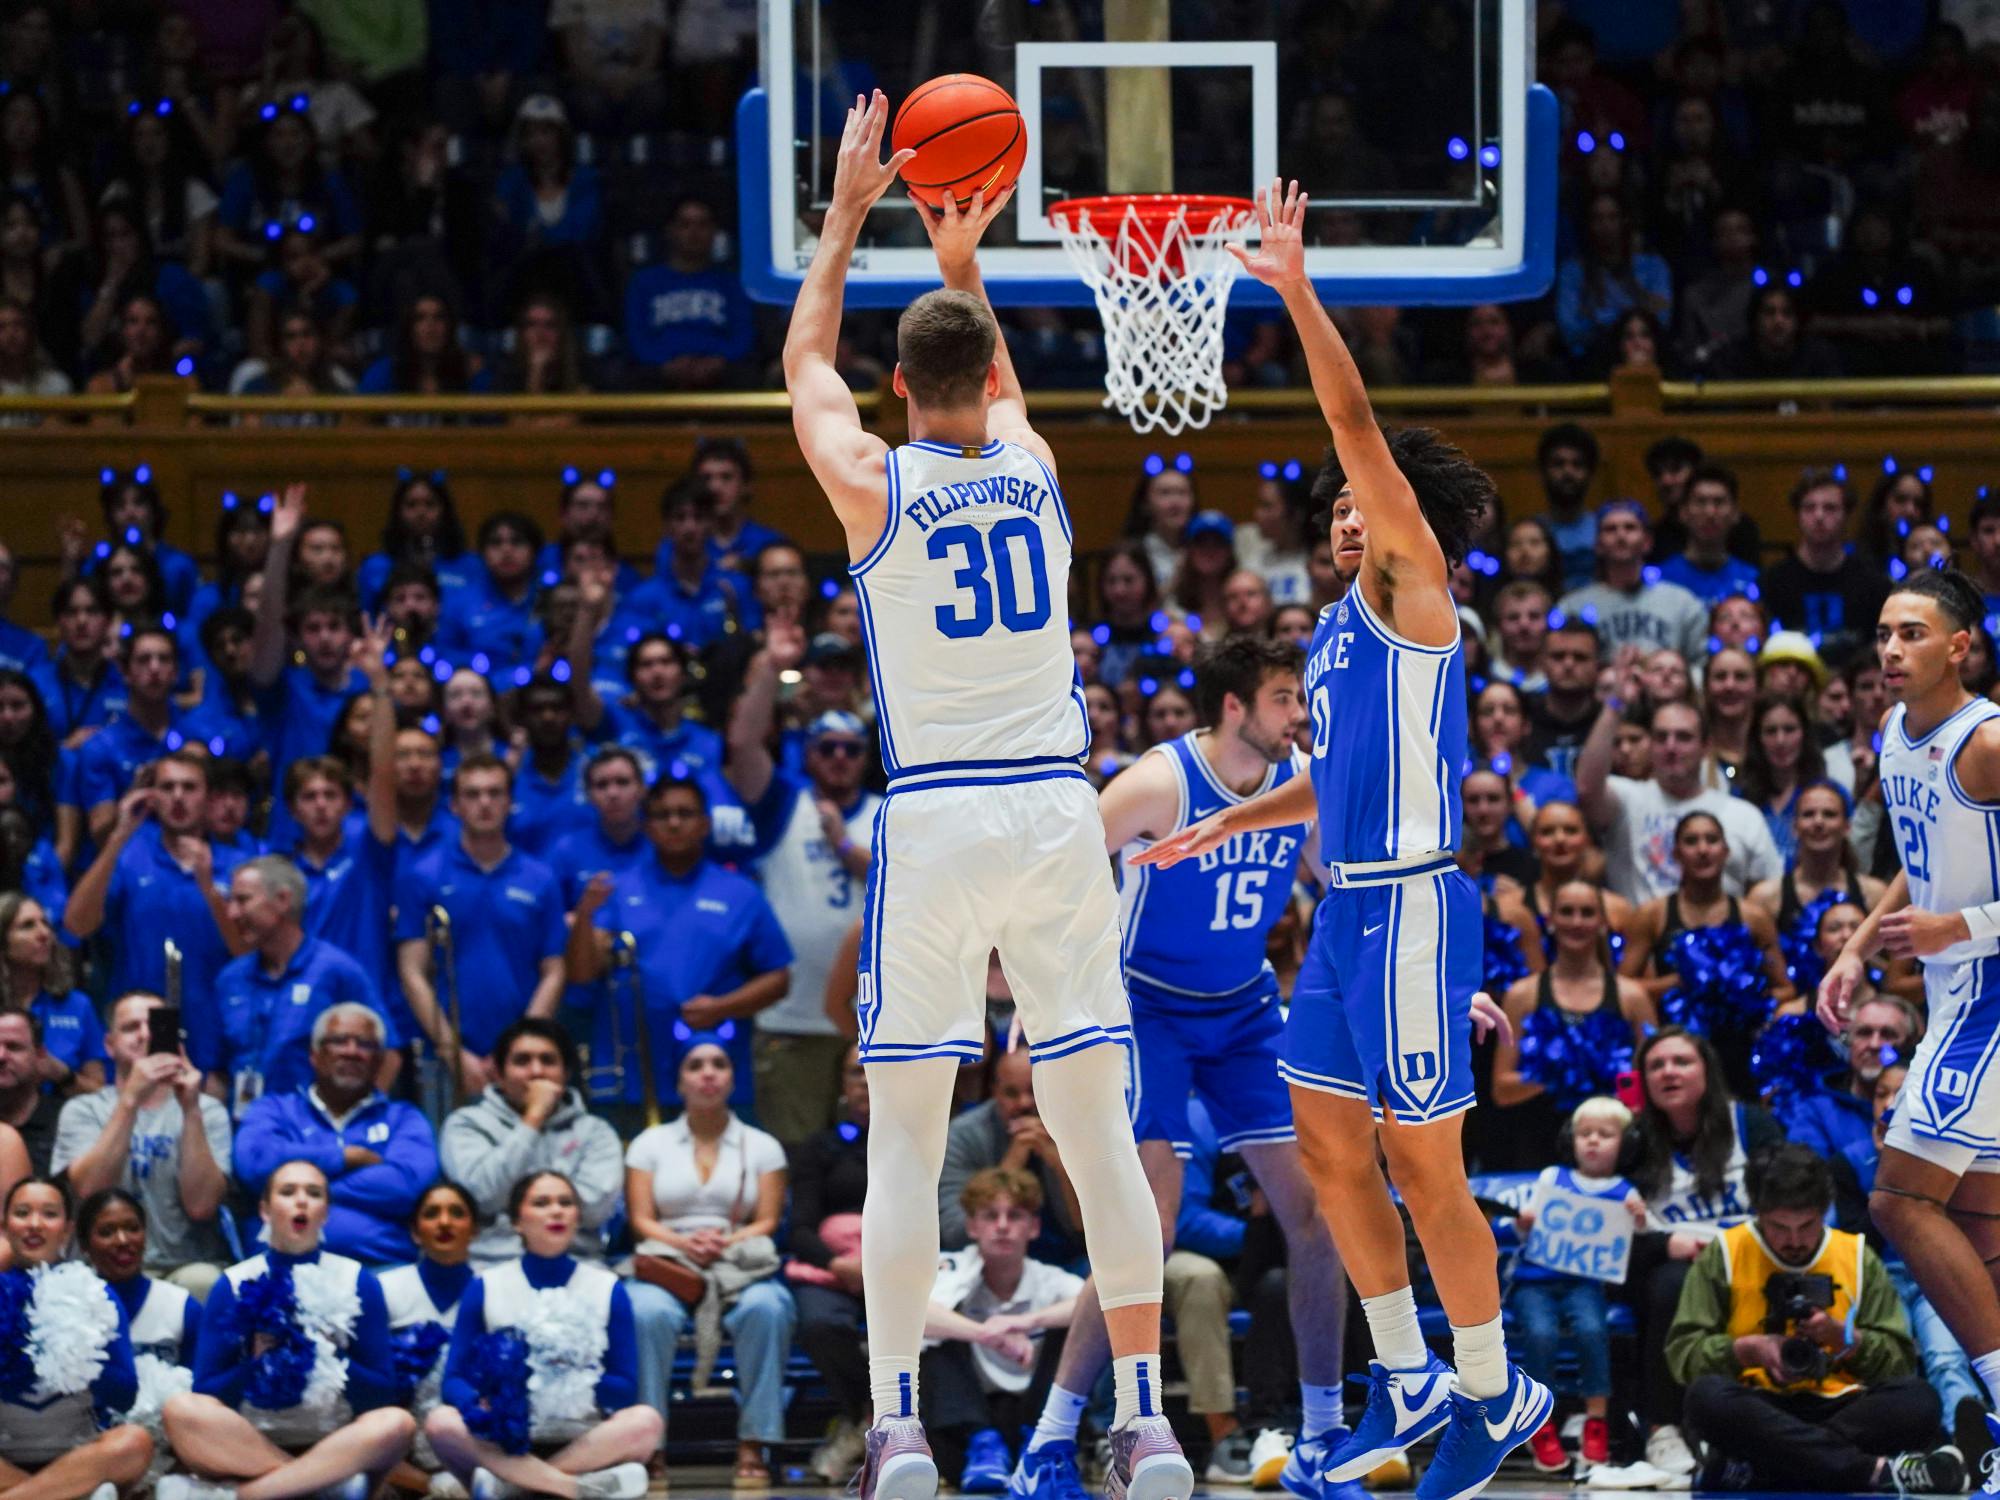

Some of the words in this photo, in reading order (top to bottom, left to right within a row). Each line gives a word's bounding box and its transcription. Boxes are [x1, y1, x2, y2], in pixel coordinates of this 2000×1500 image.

[905, 476, 1048, 532] FILIPOWSKI
[926, 516, 1051, 639] 30
[1305, 632, 1354, 697] UKE
[1881, 775, 1940, 824] DUKE
[1899, 815, 1930, 882] 21
[1210, 870, 1269, 931] 15
[1402, 1051, 1437, 1082] D
[1936, 1066, 1969, 1098] D
[1542, 1197, 1604, 1237] GO
[1662, 1181, 1757, 1224] DUK
[1525, 1229, 1626, 1276] DUKE!
